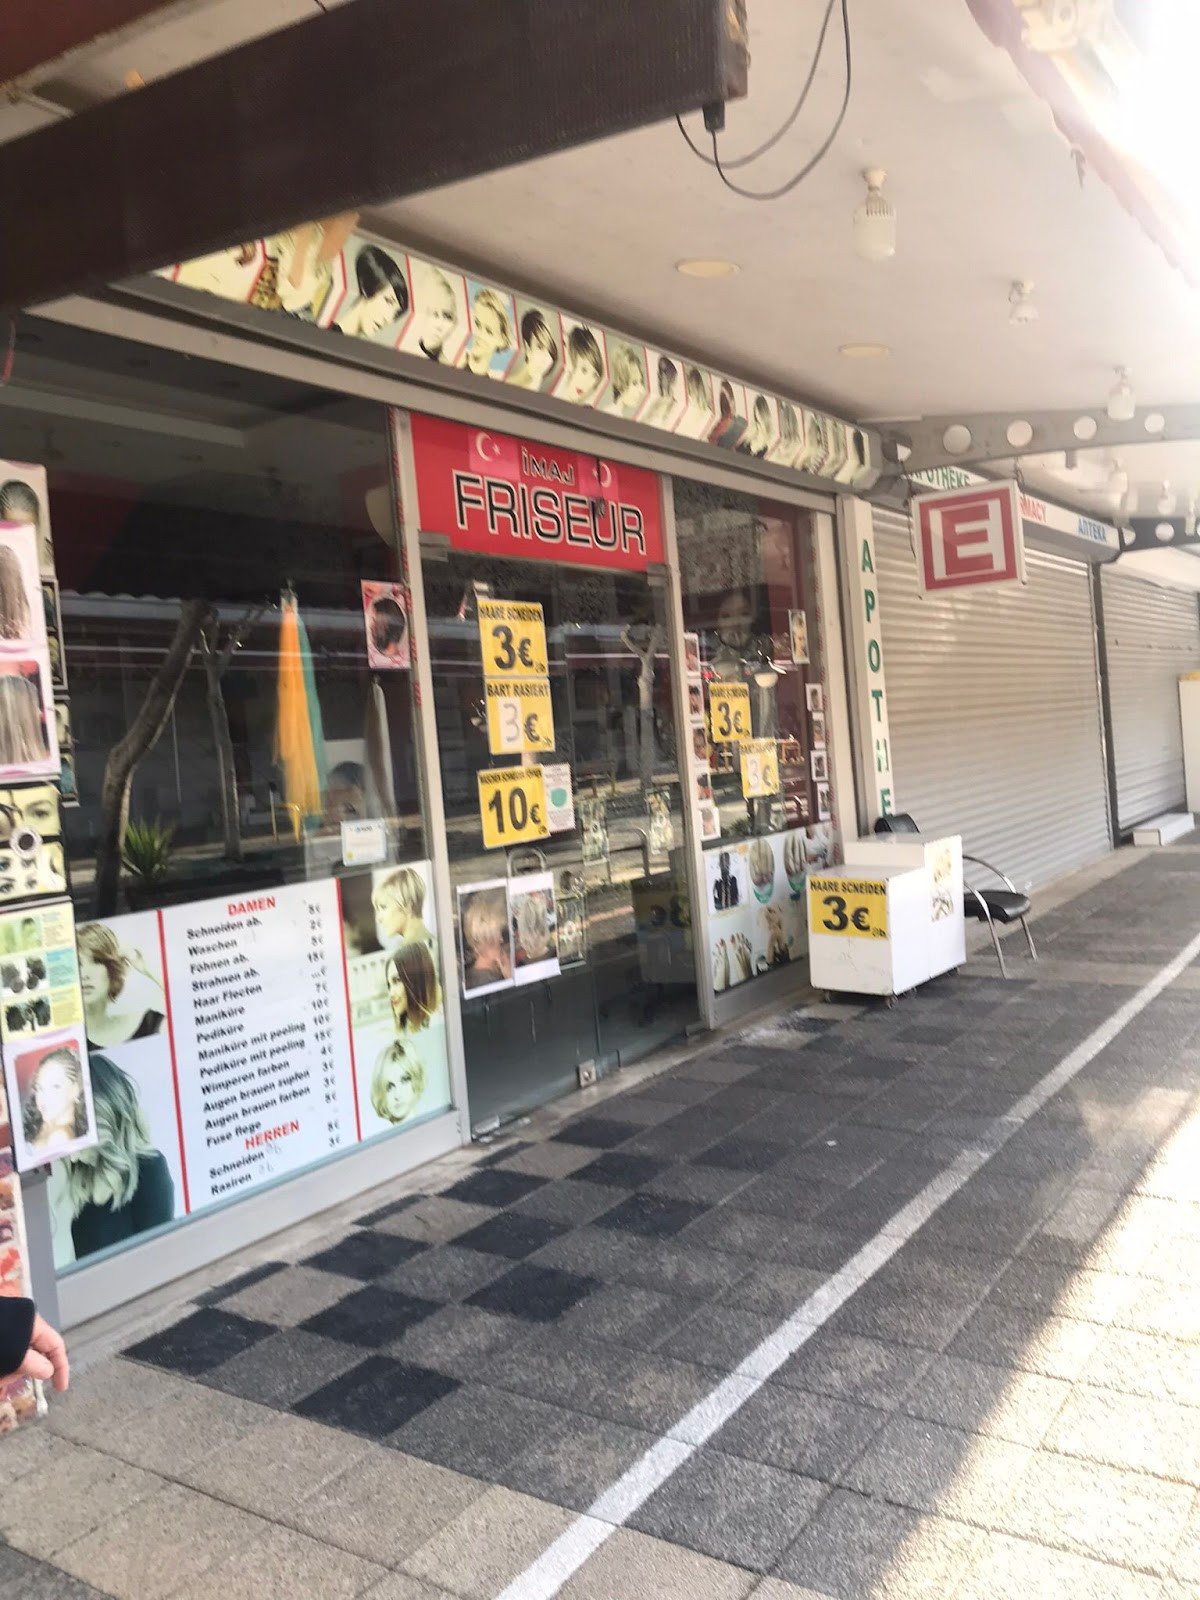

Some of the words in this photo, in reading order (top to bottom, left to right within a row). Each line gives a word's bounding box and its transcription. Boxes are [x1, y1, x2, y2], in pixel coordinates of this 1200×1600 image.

[452, 469, 647, 556] FRISEUR
[487, 684, 511, 697] BART
[227, 896, 276, 916] DAMEN
[823, 895, 871, 932] 3€
[187, 920, 244, 939] Schneiden
[188, 938, 238, 956] Waschen
[193, 995, 220, 1009] Haar
[250, 1032, 268, 1046] mit
[270, 1022, 306, 1042] peeling
[250, 1048, 267, 1063] mit
[269, 1038, 305, 1058] peeling
[201, 1071, 255, 1096] Wimperen
[203, 1095, 237, 1113] Augen
[239, 1081, 276, 1100] brauen
[205, 1113, 239, 1131] Augen
[241, 1098, 277, 1117] brauen
[245, 1120, 300, 1149] HERREN
[209, 1151, 265, 1179] Schneiden
